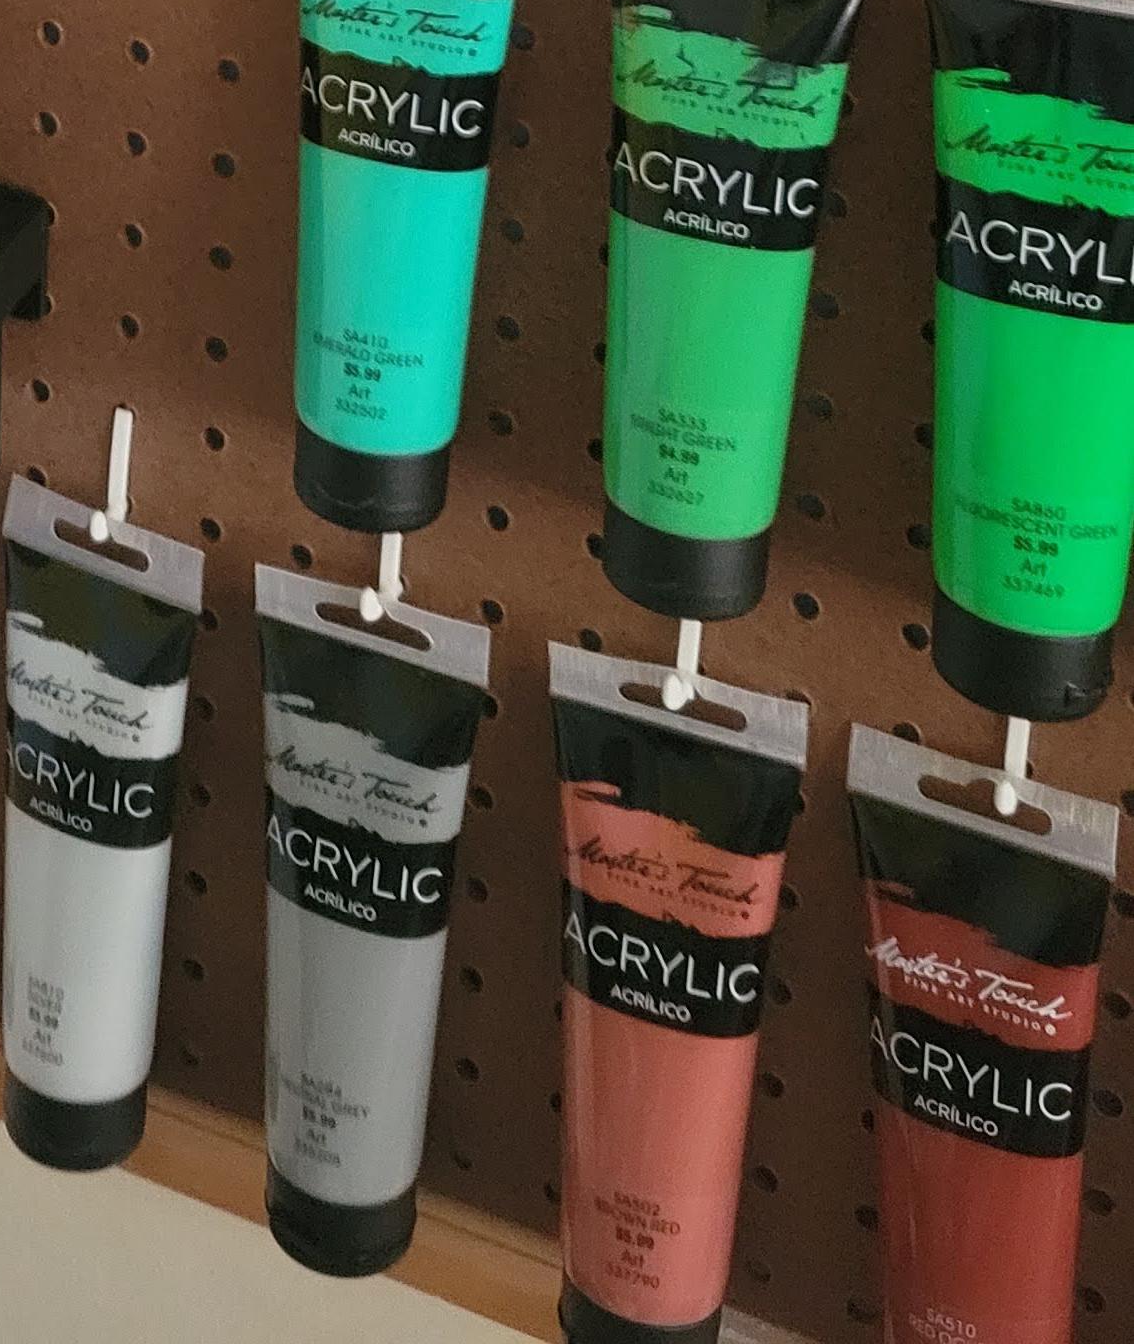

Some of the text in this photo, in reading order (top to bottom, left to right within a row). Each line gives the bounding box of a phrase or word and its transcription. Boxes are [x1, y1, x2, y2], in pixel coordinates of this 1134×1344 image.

[405, 9, 490, 42] Touch
[302, 66, 485, 139] ACRYLIC
[338, 128, 415, 157] ACRÍLICO
[1077, 143, 1134, 173] Tou
[614, 141, 820, 218] ACRYLIC
[664, 208, 751, 239] ACRÍLICO
[946, 210, 1134, 285] ACRYL
[1009, 279, 1104, 311] ACRÍLICO
[374, 352, 424, 367] GREEN
[267, 813, 443, 904] ACRYLIC
[304, 883, 377, 922] ACRÍLICO
[565, 912, 760, 1003] ACRYLIC
[611, 984, 692, 1023] ACRÍLICO
[975, 969, 1073, 1020] Touch
[870, 1015, 1073, 1121] ACRYLIC
[914, 1094, 999, 1136] ACRÍLICO
